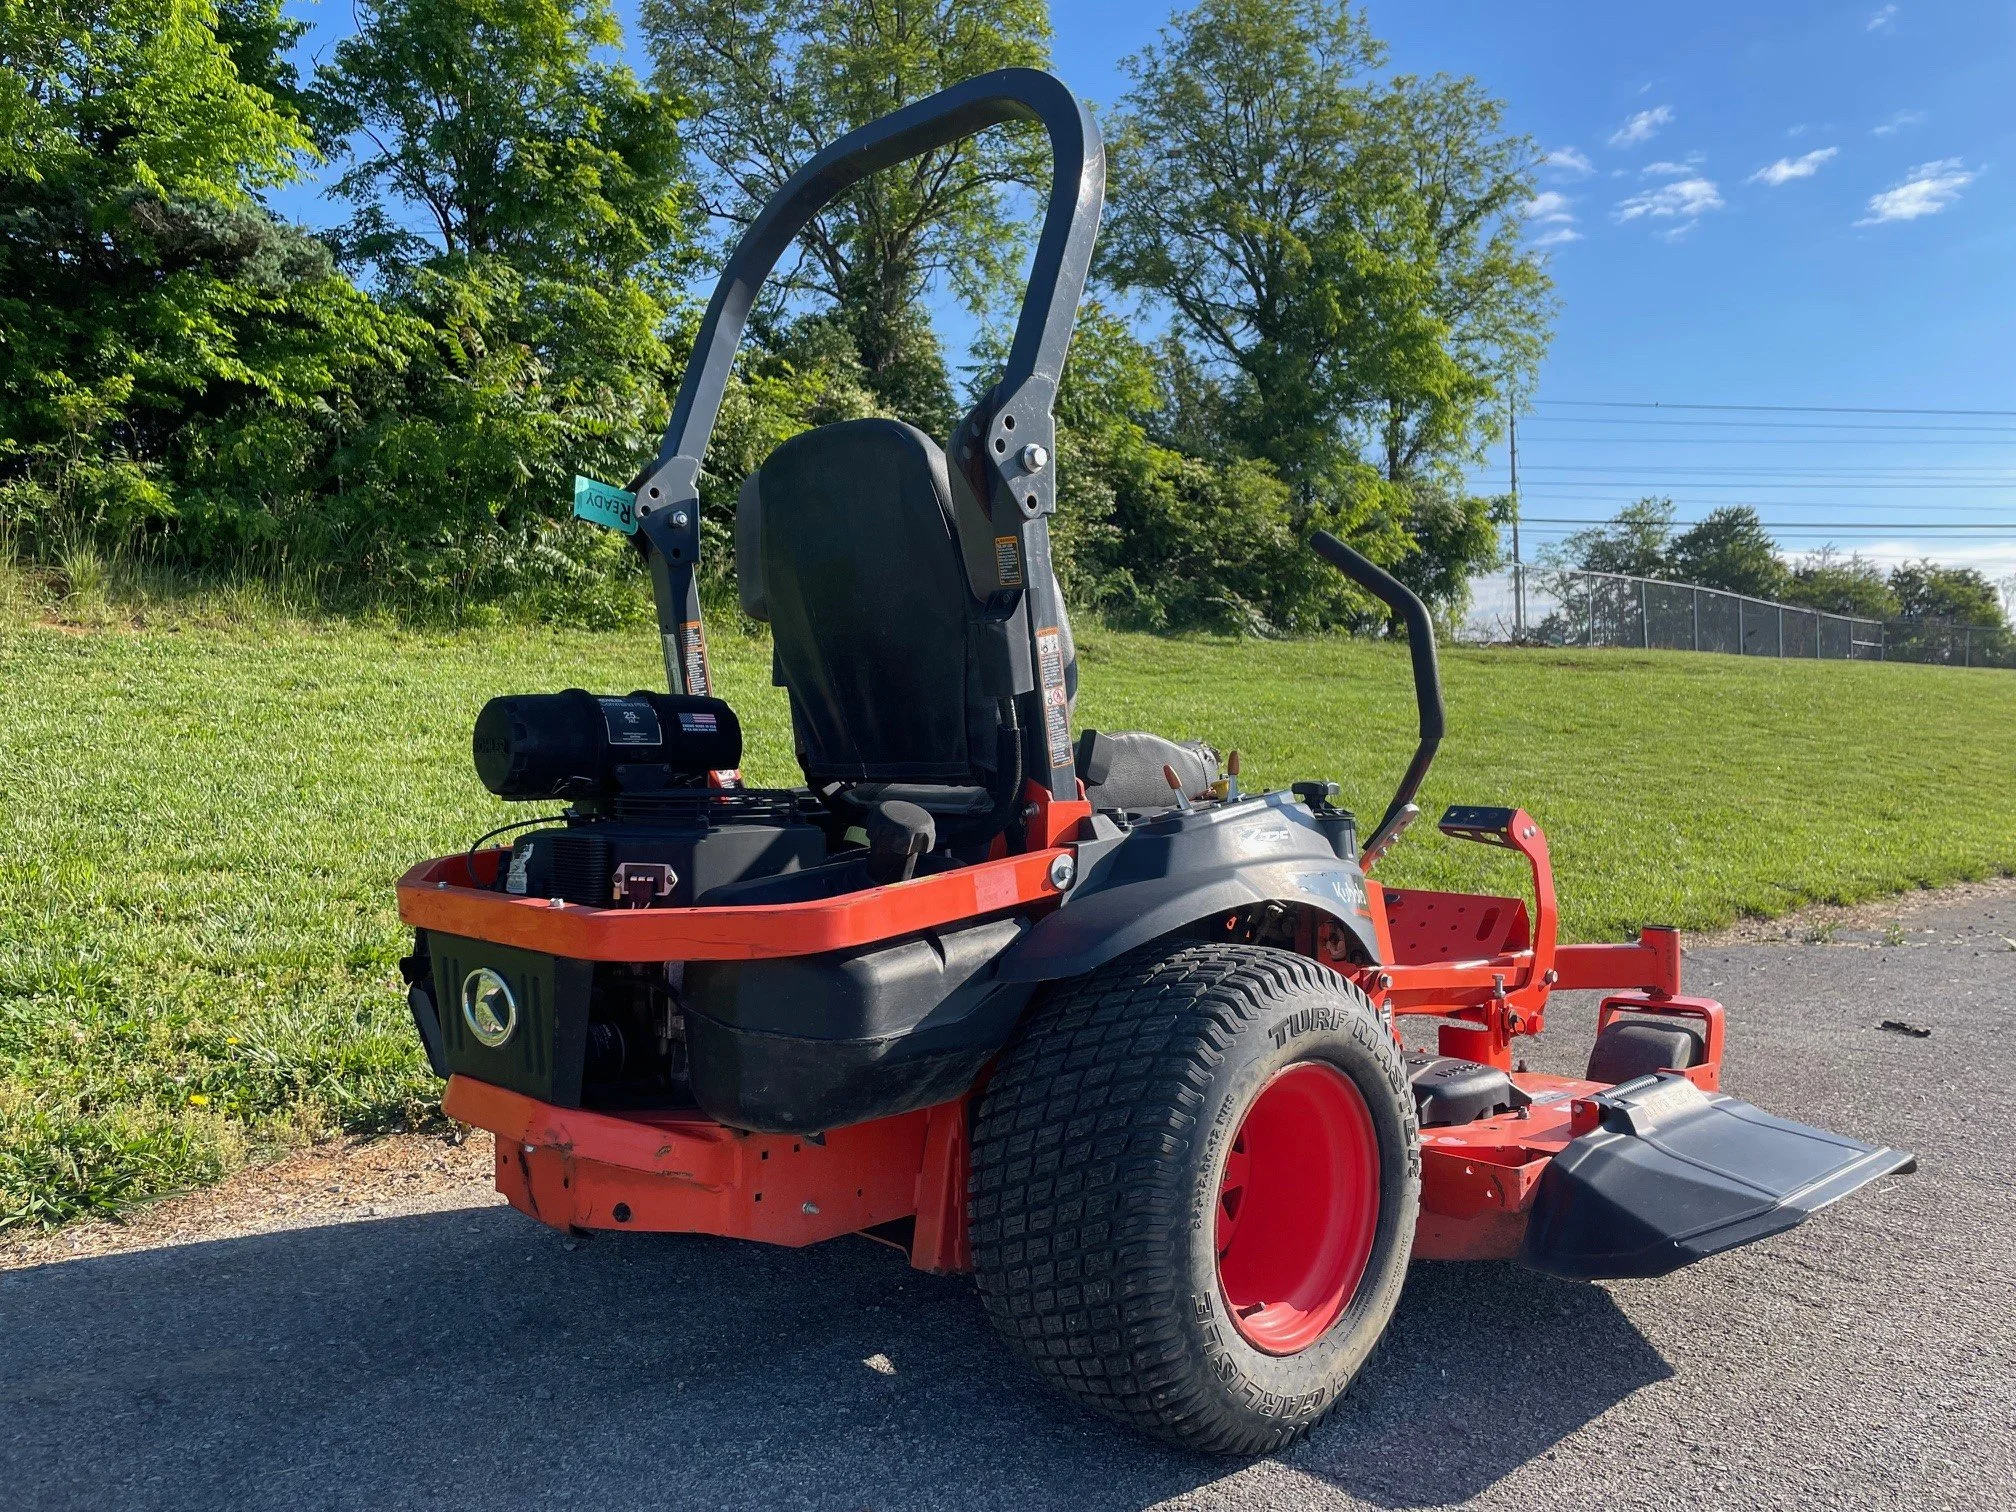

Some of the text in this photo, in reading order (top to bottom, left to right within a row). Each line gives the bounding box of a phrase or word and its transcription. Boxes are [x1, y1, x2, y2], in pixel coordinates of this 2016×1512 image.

[586, 492, 631, 525] READY
[623, 711, 636, 719] 25
[1331, 881, 1367, 905] Kubota
[1268, 1007, 1420, 1178] TURF MASTER
[1191, 1290, 1326, 1419] CARLISLE
